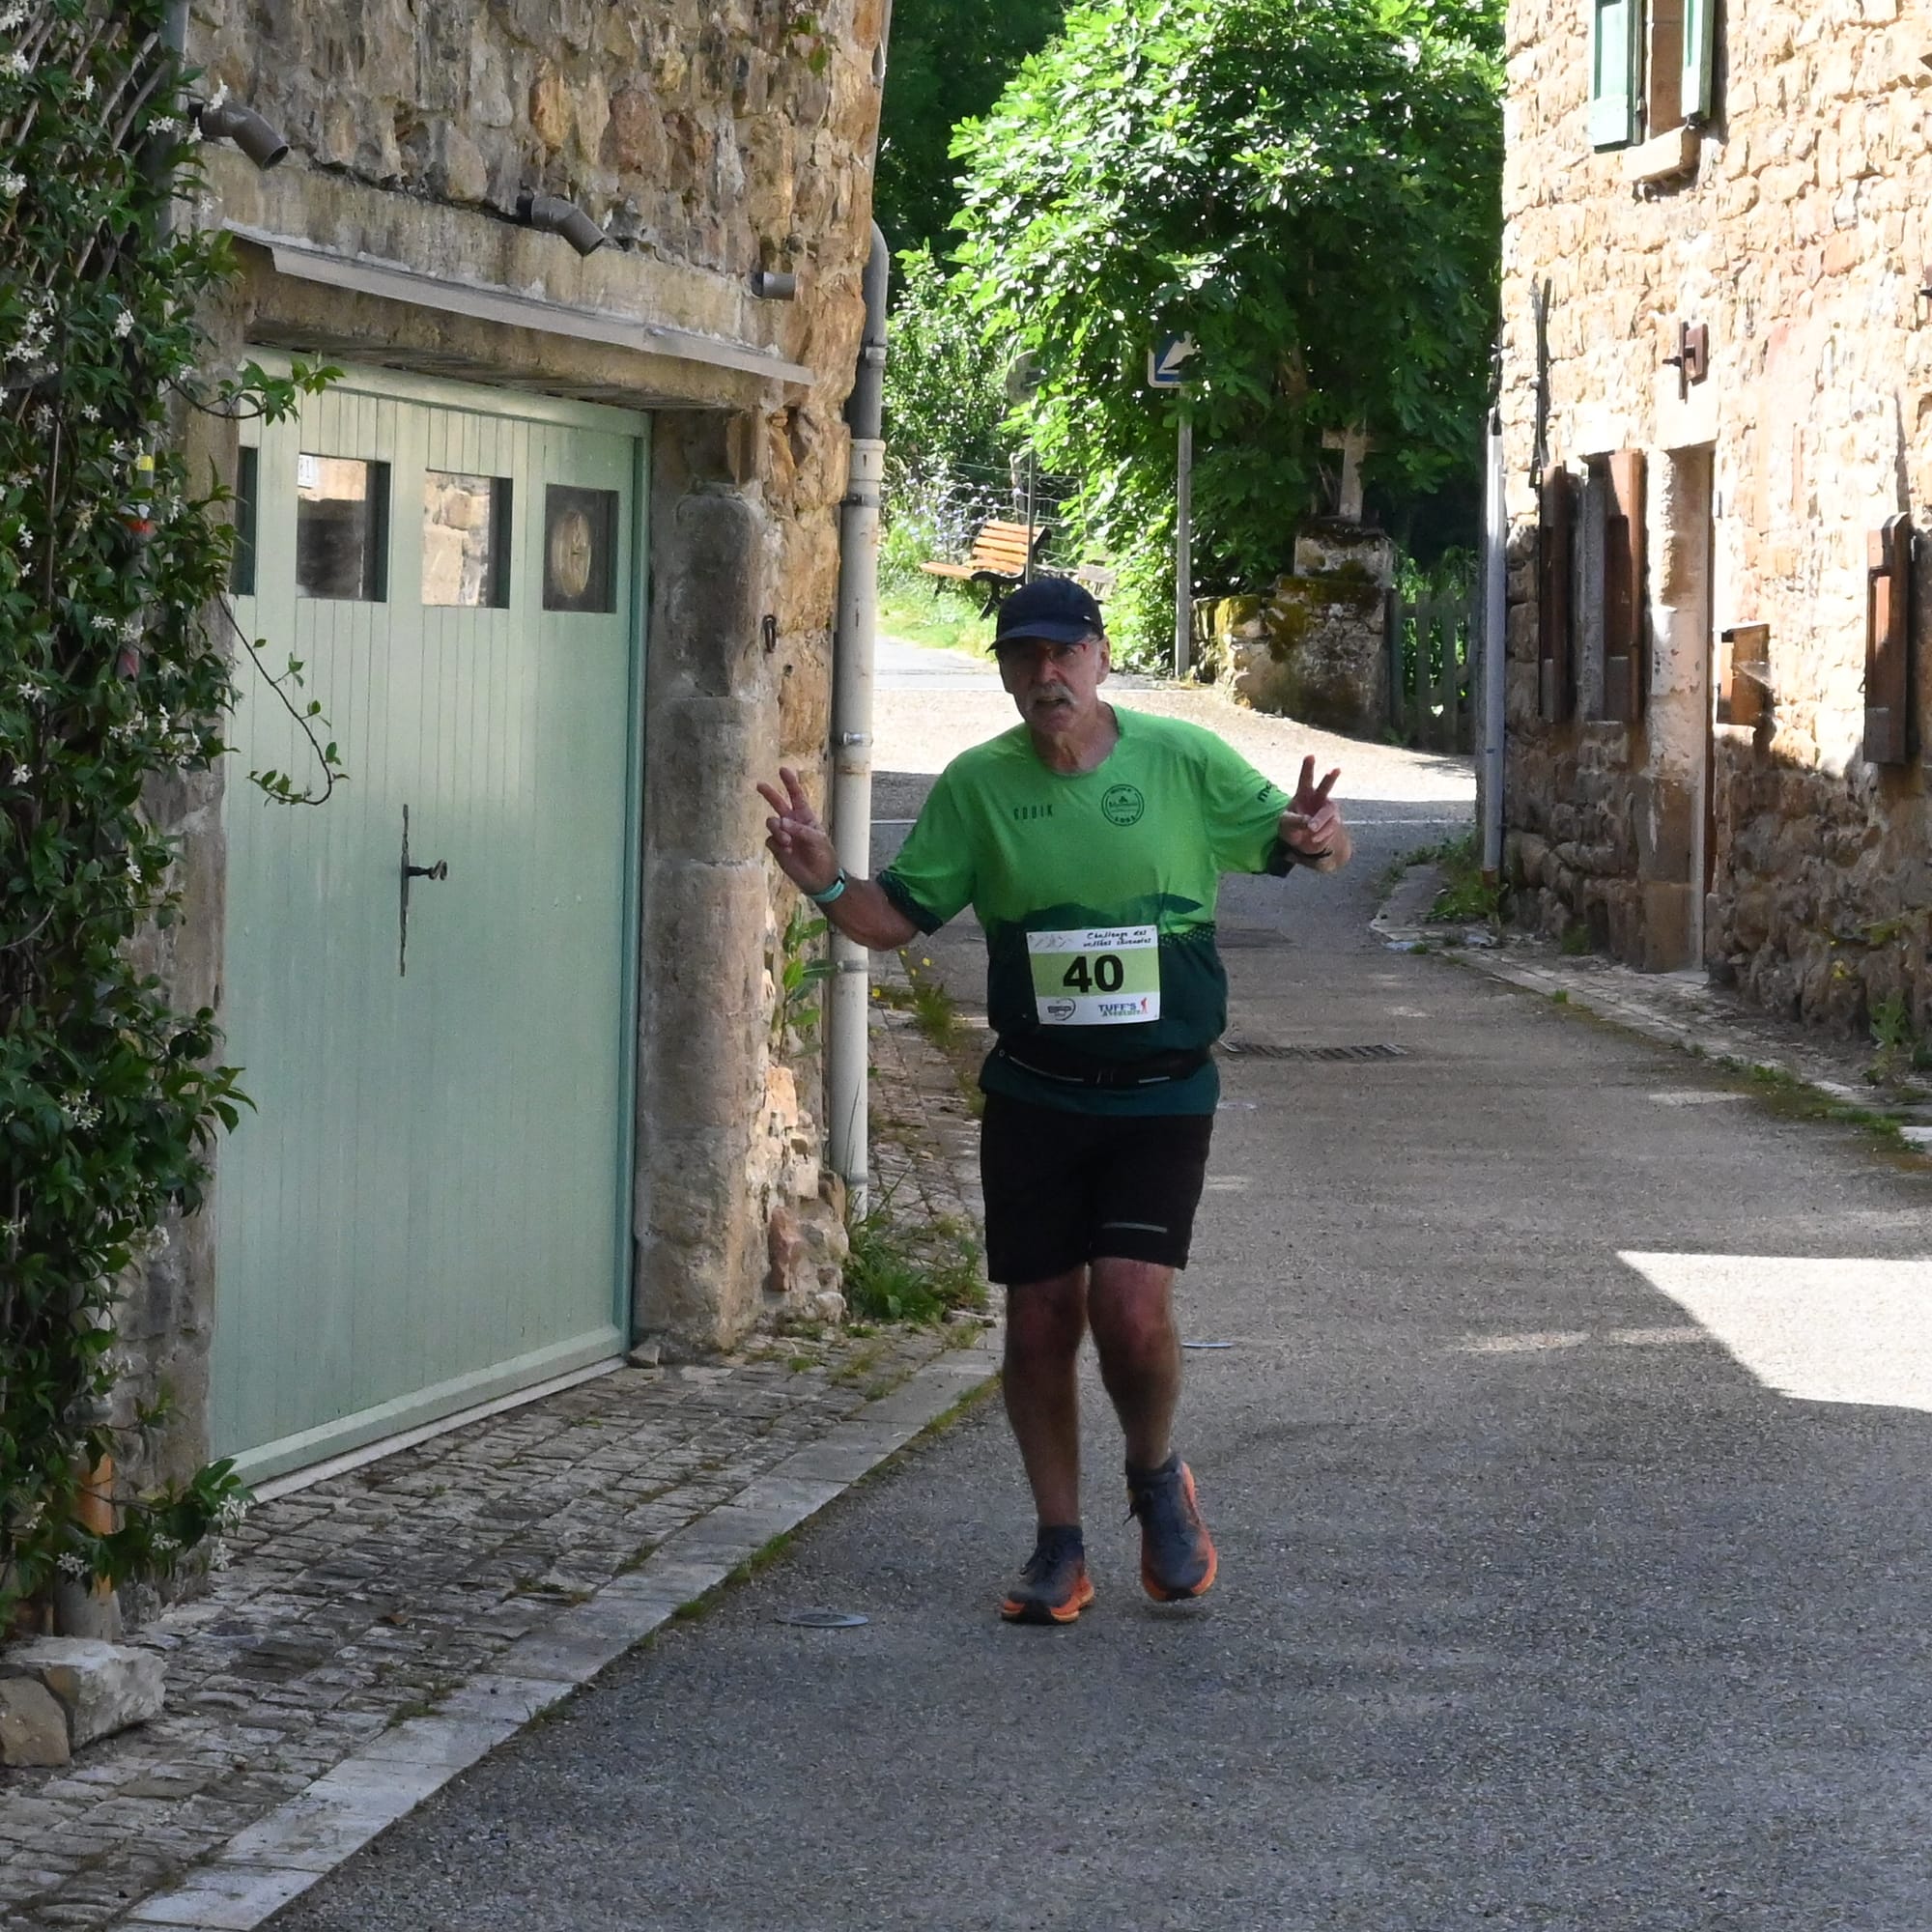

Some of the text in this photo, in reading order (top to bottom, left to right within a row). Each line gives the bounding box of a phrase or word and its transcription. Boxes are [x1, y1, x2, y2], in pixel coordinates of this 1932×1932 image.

[1087, 930, 1128, 940] Challenge
[1063, 954, 1124, 993] 40
[1097, 1002, 1137, 1012] TUFF'S
